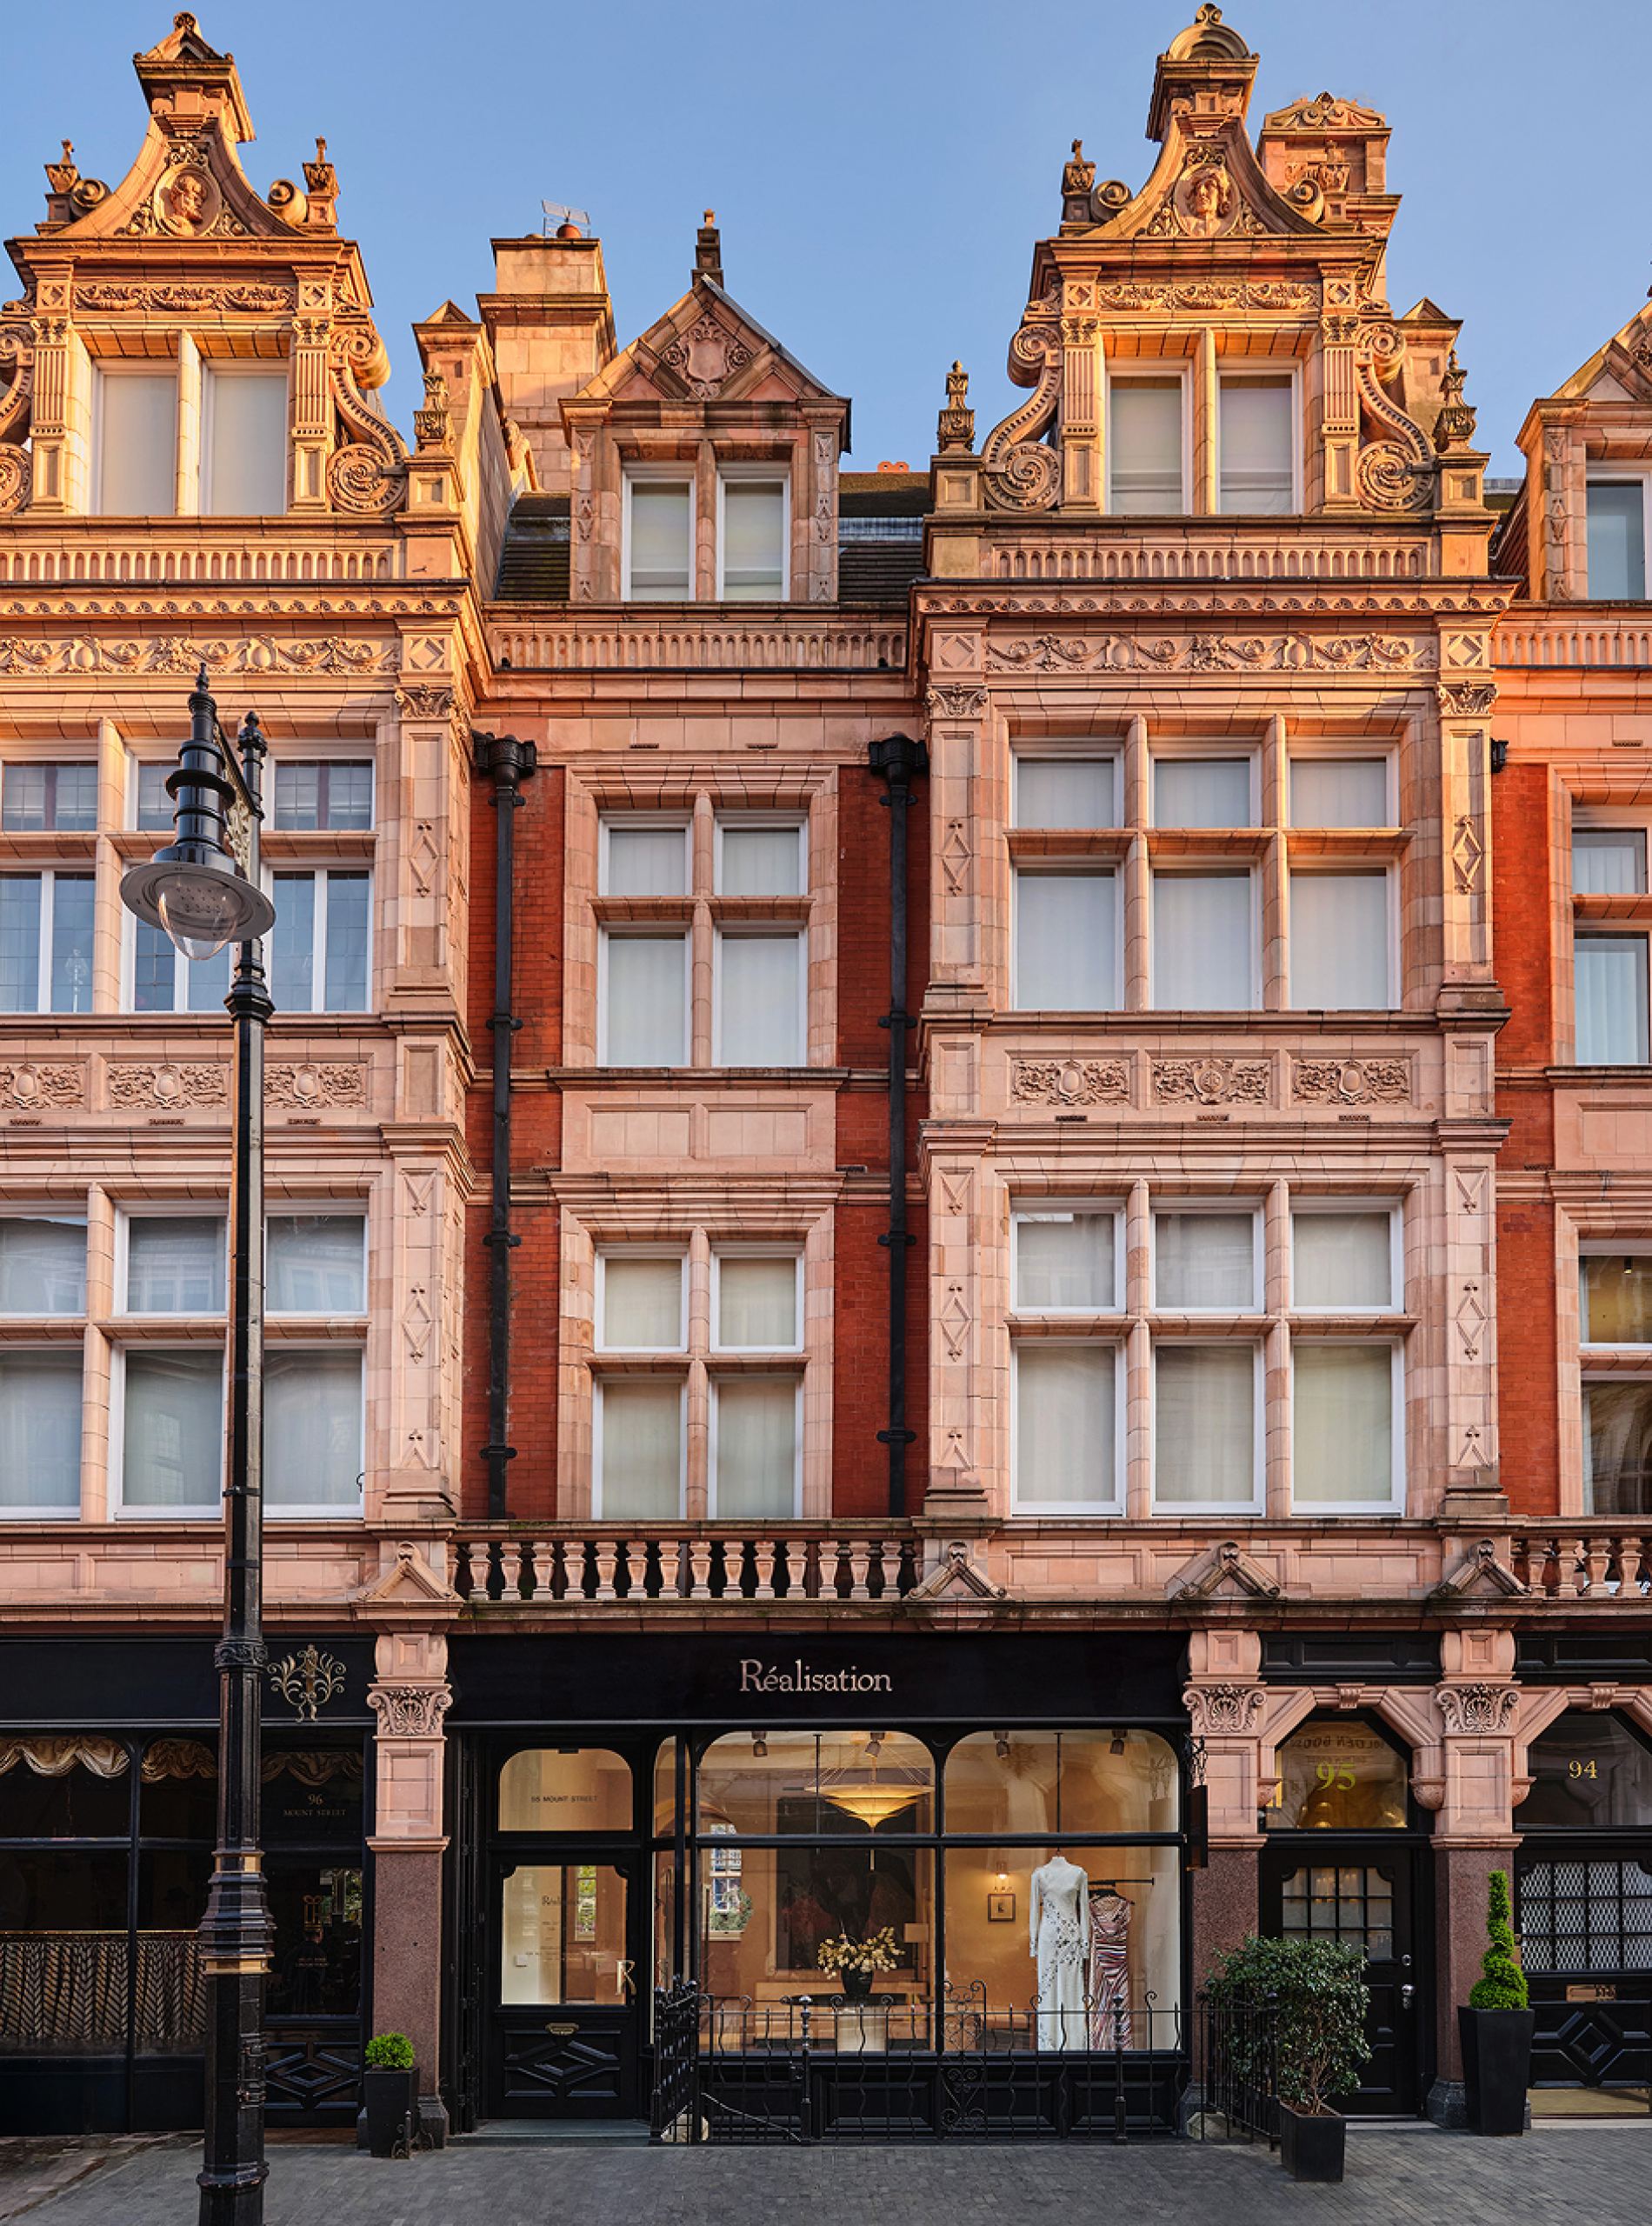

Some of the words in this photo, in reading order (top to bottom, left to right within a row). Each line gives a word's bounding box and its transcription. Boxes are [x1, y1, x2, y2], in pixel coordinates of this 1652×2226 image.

[739, 1658, 893, 1692] Réalisation
[1316, 1762, 1356, 1790] 95
[1569, 1760, 1599, 1779] 94
[307, 1794, 324, 1804] 96
